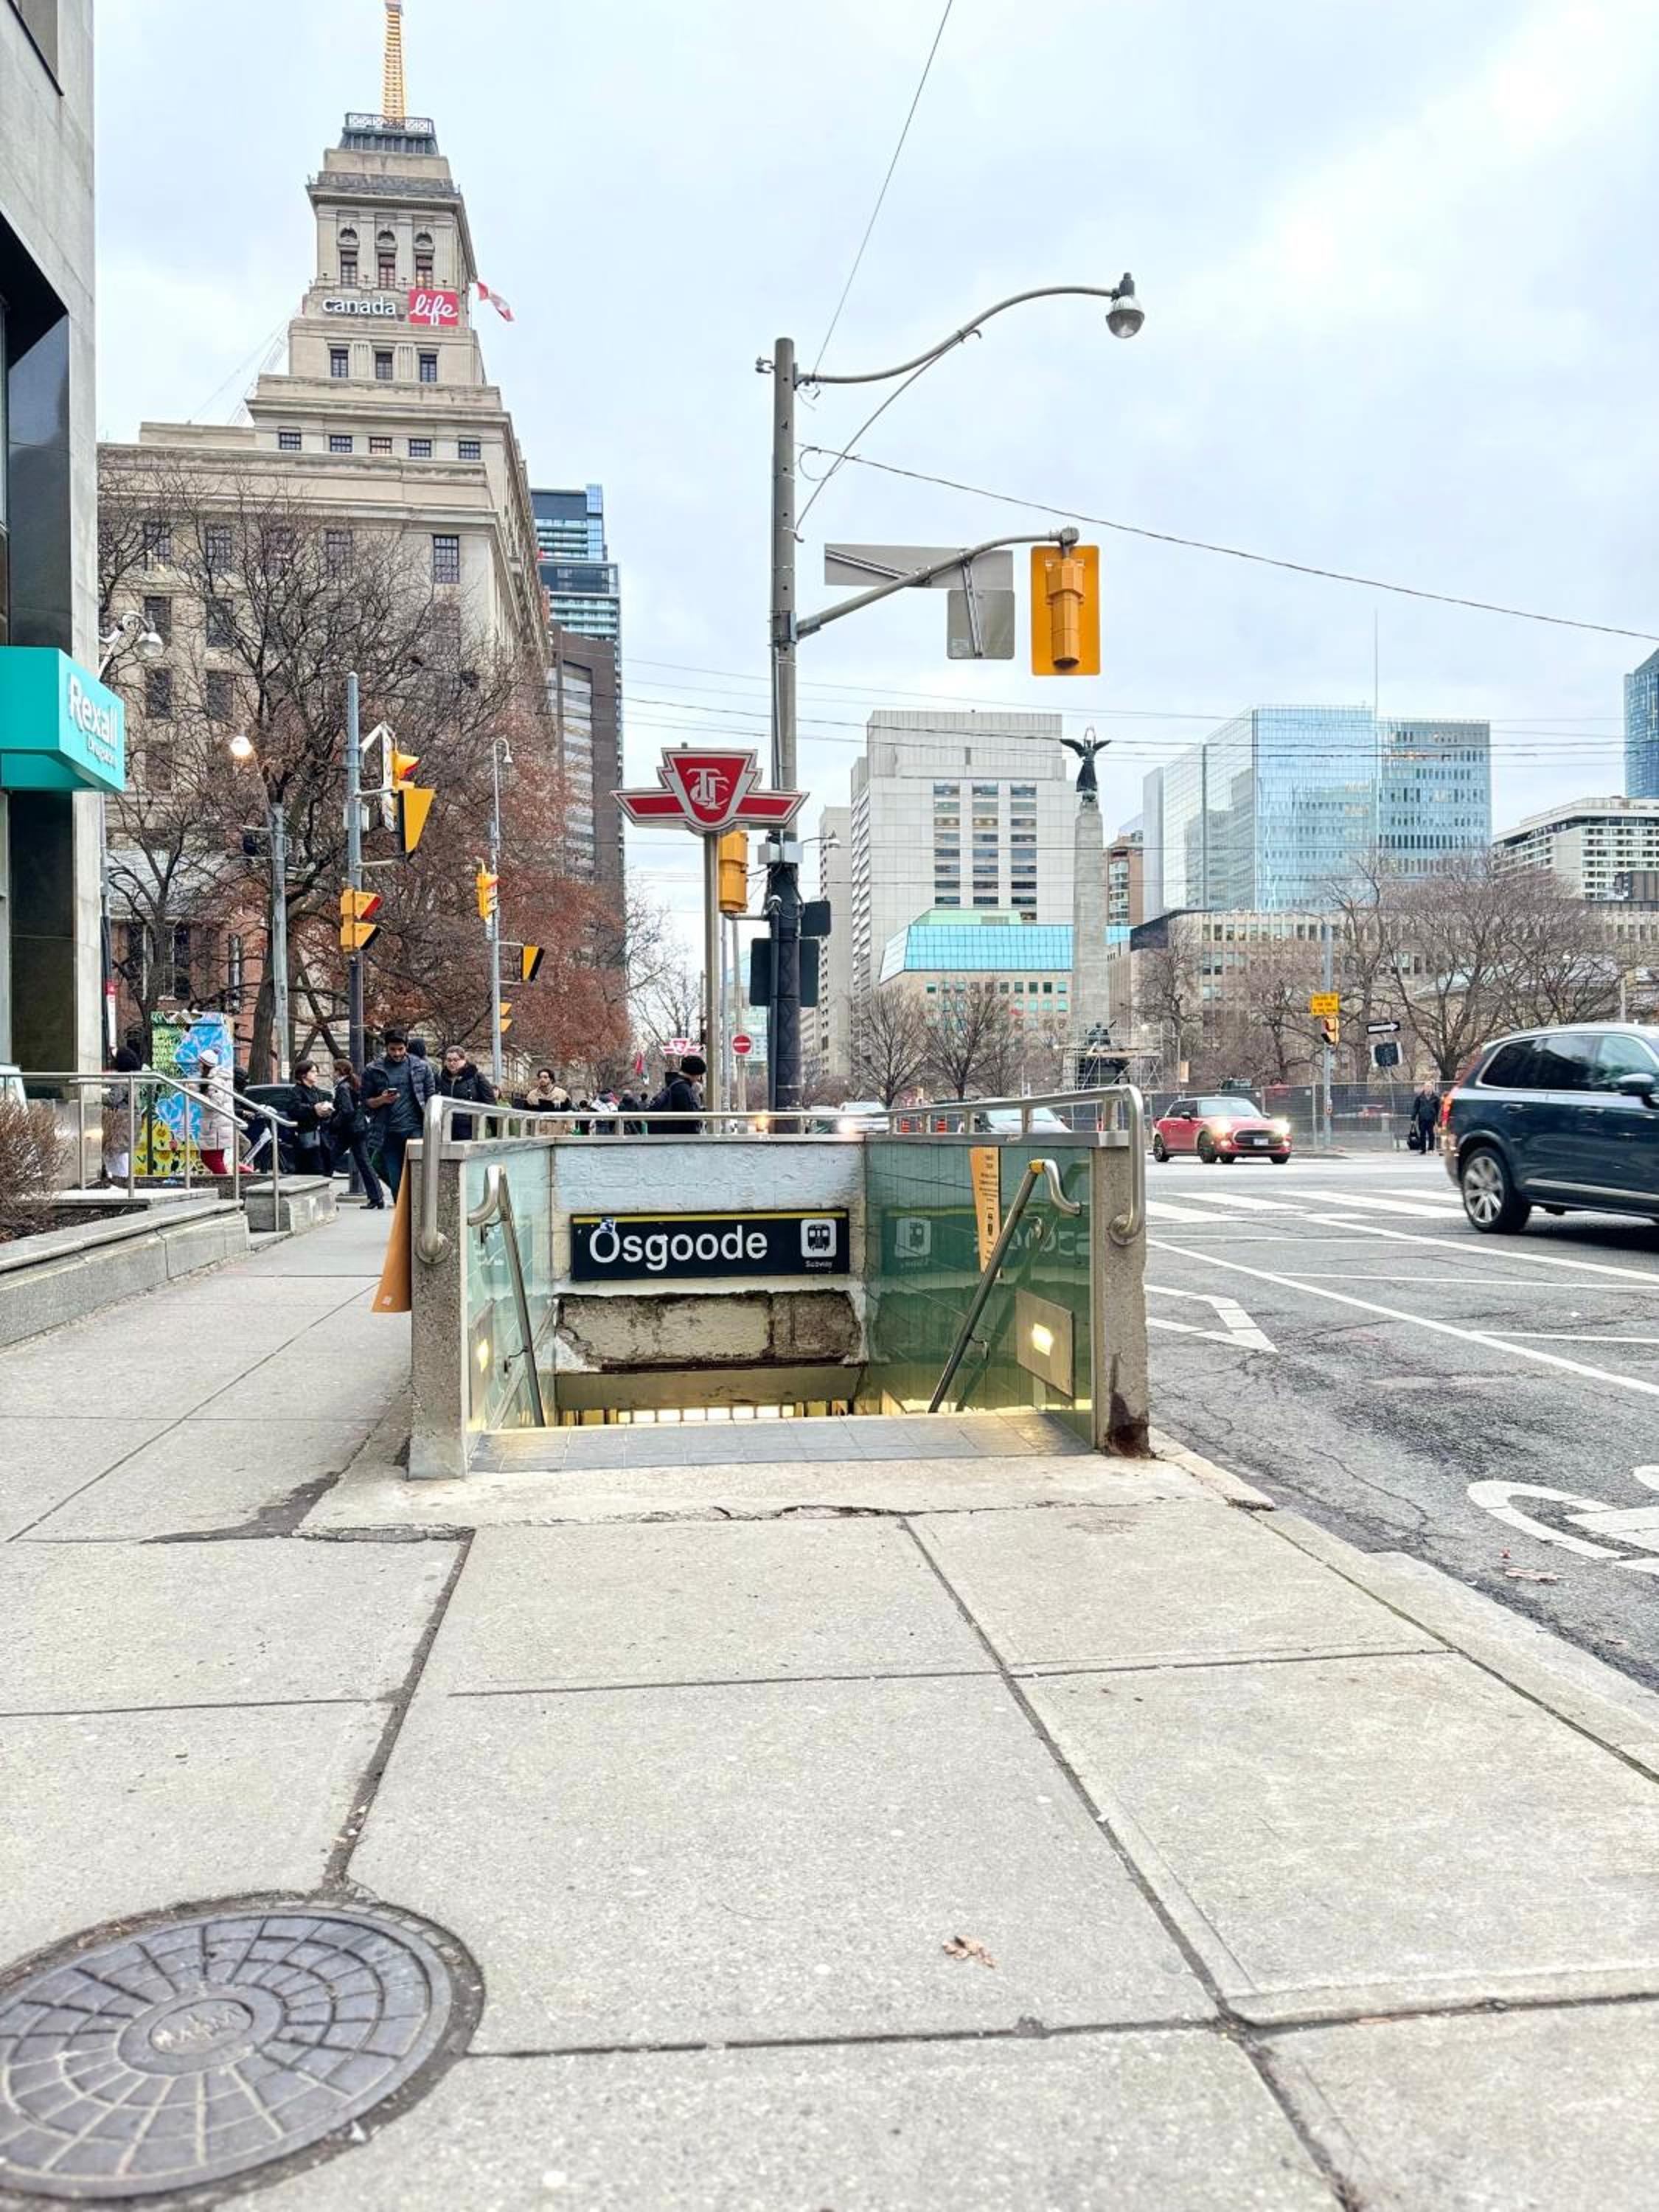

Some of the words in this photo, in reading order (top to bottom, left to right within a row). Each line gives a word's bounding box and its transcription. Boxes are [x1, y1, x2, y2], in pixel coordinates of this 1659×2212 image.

[322, 296, 397, 316] canada
[410, 294, 459, 326] life
[68, 672, 118, 751] Rexall
[589, 1224, 768, 1271] Osgoode
